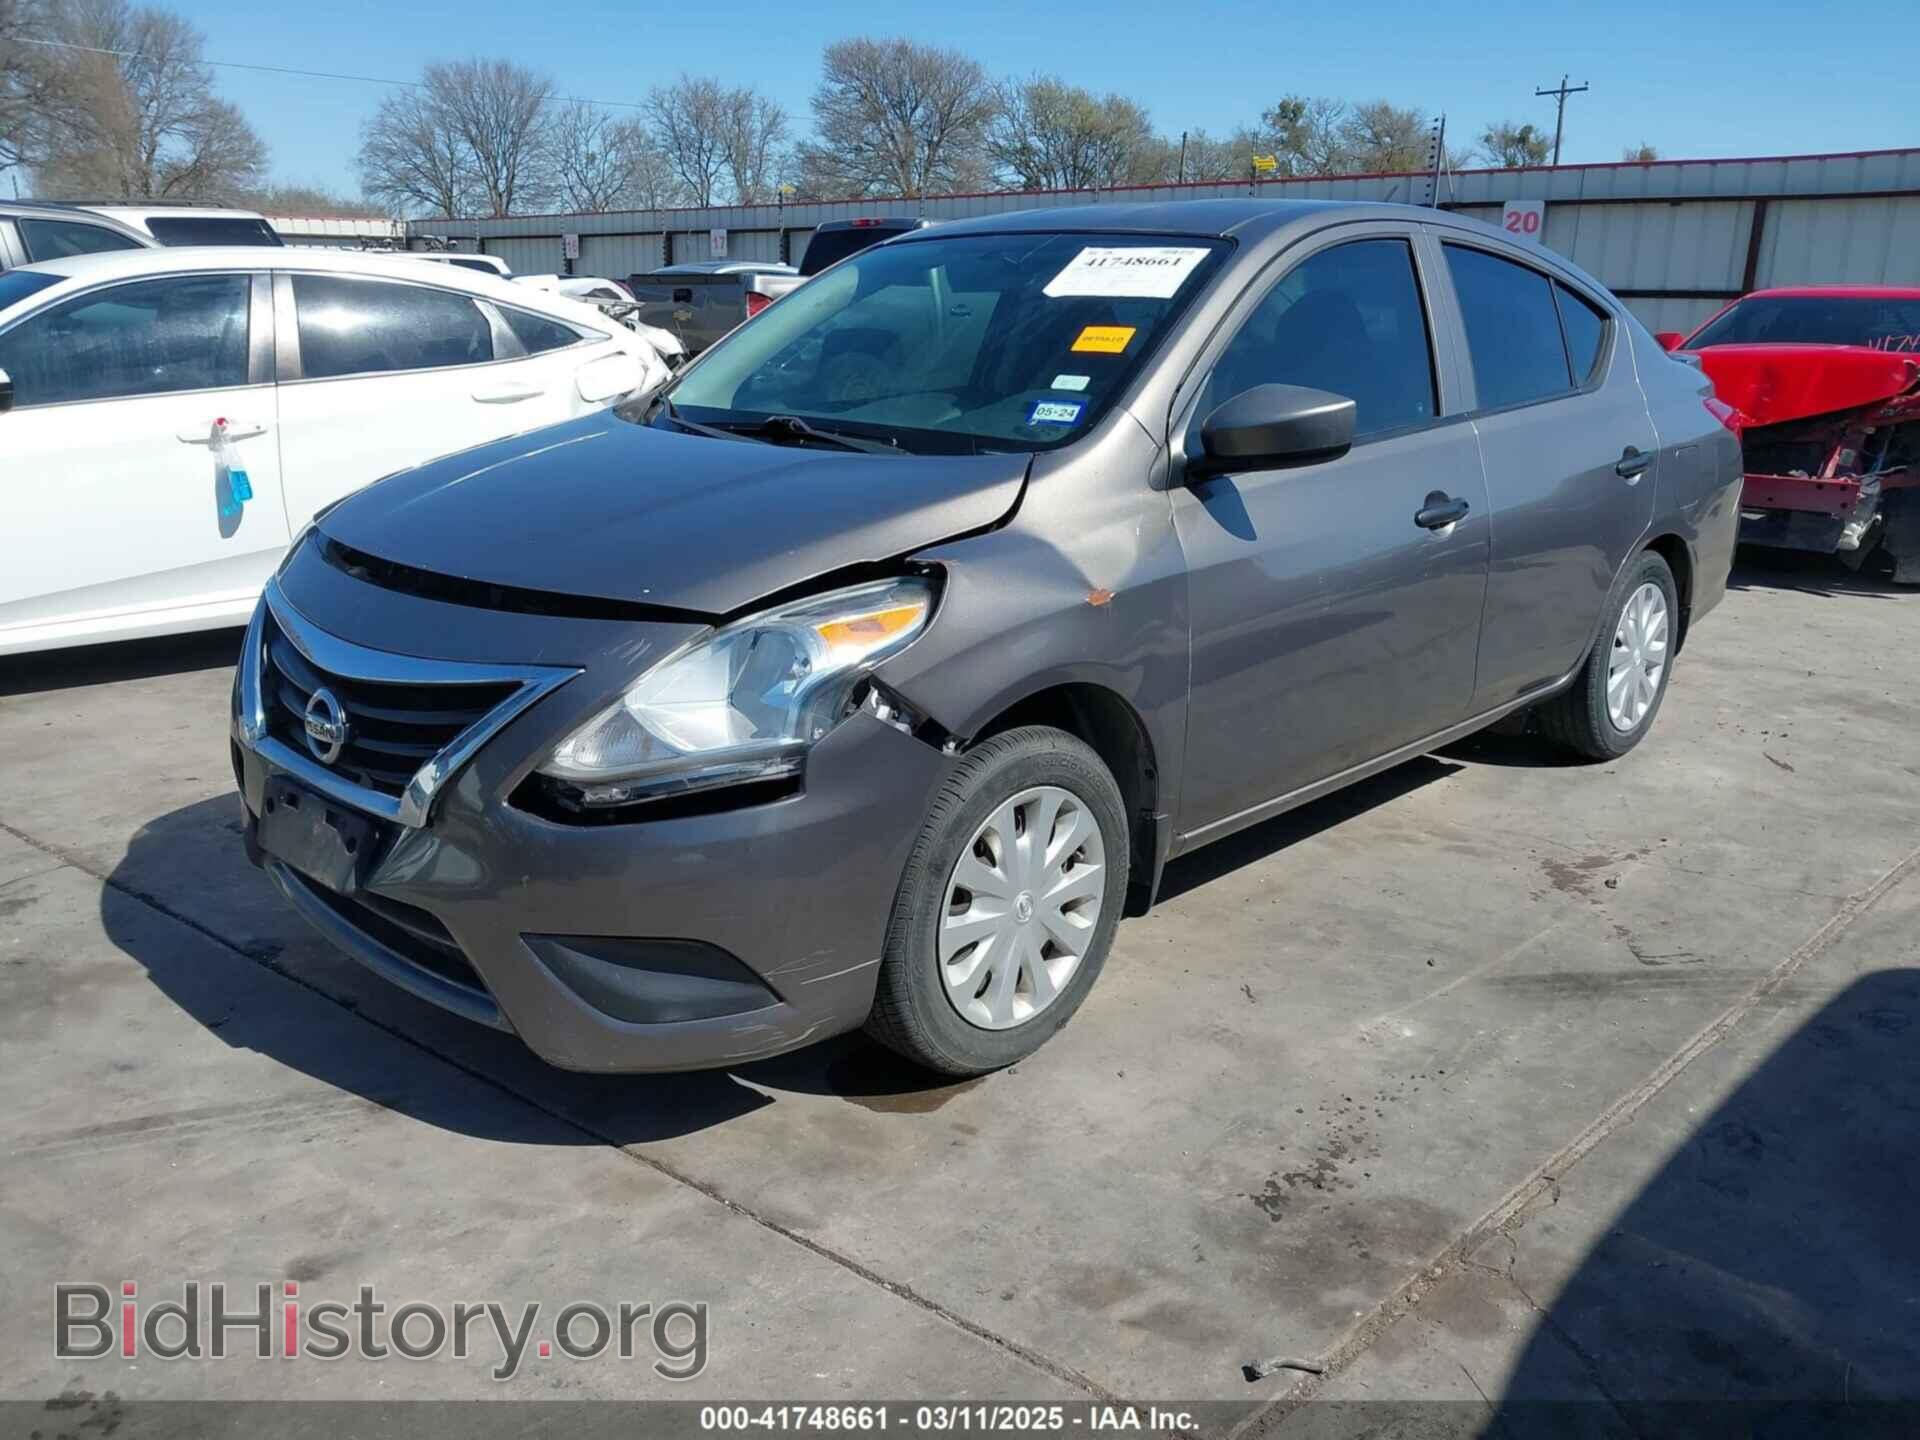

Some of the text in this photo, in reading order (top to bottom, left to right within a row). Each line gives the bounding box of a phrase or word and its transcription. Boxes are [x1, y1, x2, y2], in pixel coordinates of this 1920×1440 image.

[1505, 210, 1539, 234] 20
[1084, 256, 1182, 267] 41748661
[1036, 406, 1076, 418] 05-24
